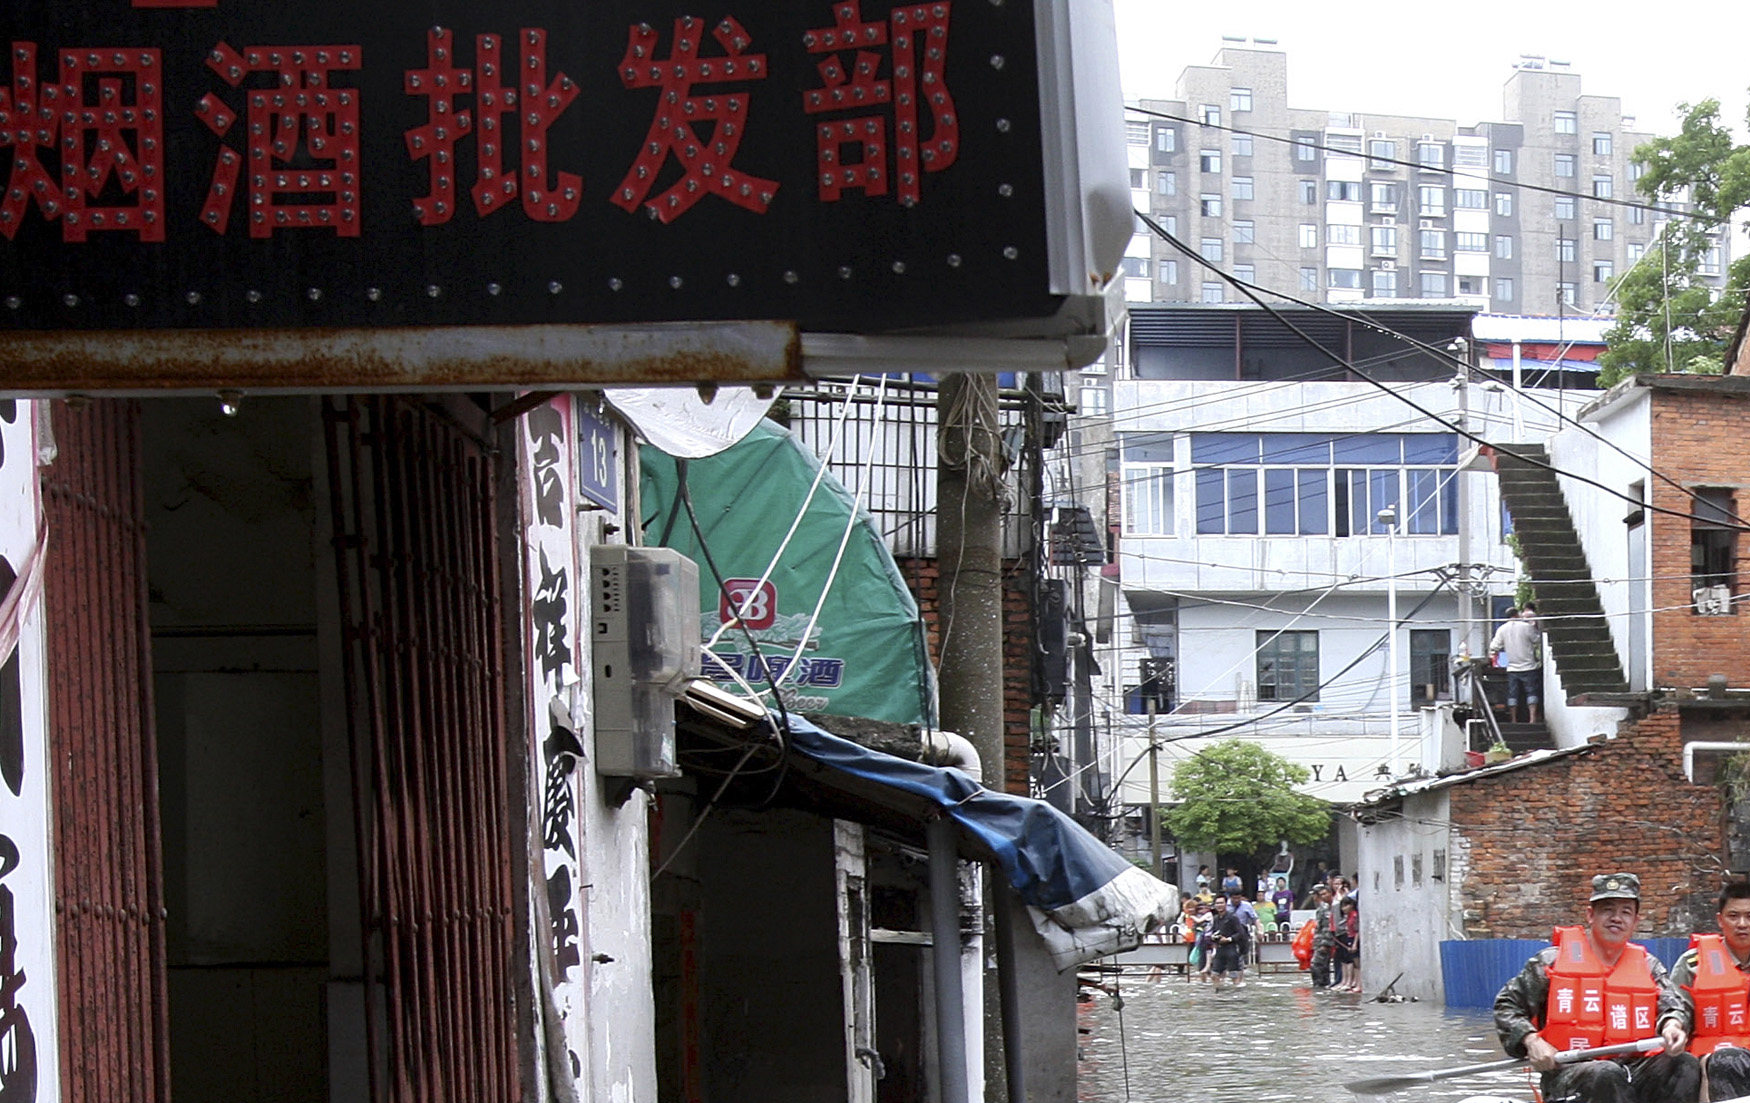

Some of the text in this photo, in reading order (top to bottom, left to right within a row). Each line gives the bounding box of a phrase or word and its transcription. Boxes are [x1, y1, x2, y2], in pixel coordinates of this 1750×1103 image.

[0, 1, 961, 243] 烟酒批发部
[591, 428, 607, 488] 13
[1557, 988, 1650, 1030] 青云谱区
